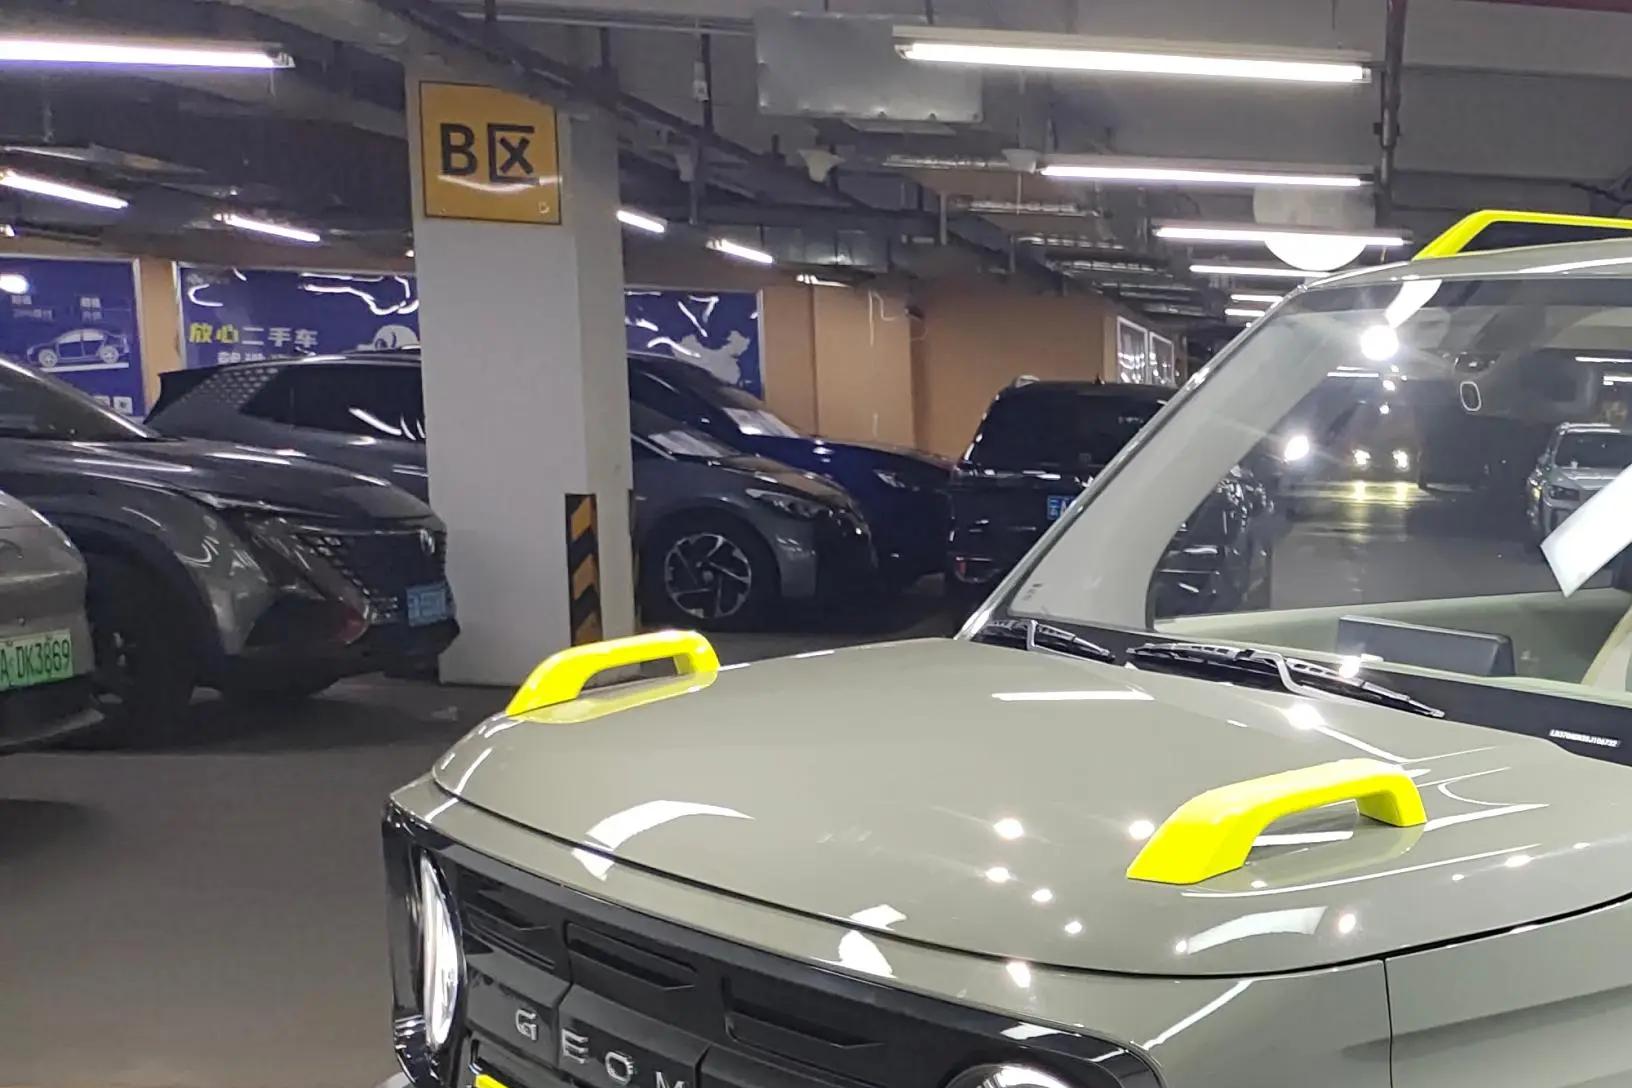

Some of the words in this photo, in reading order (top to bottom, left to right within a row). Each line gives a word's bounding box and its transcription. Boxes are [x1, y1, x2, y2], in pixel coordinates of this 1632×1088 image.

[440, 122, 540, 184] B区
[189, 322, 319, 348] 放心二手车
